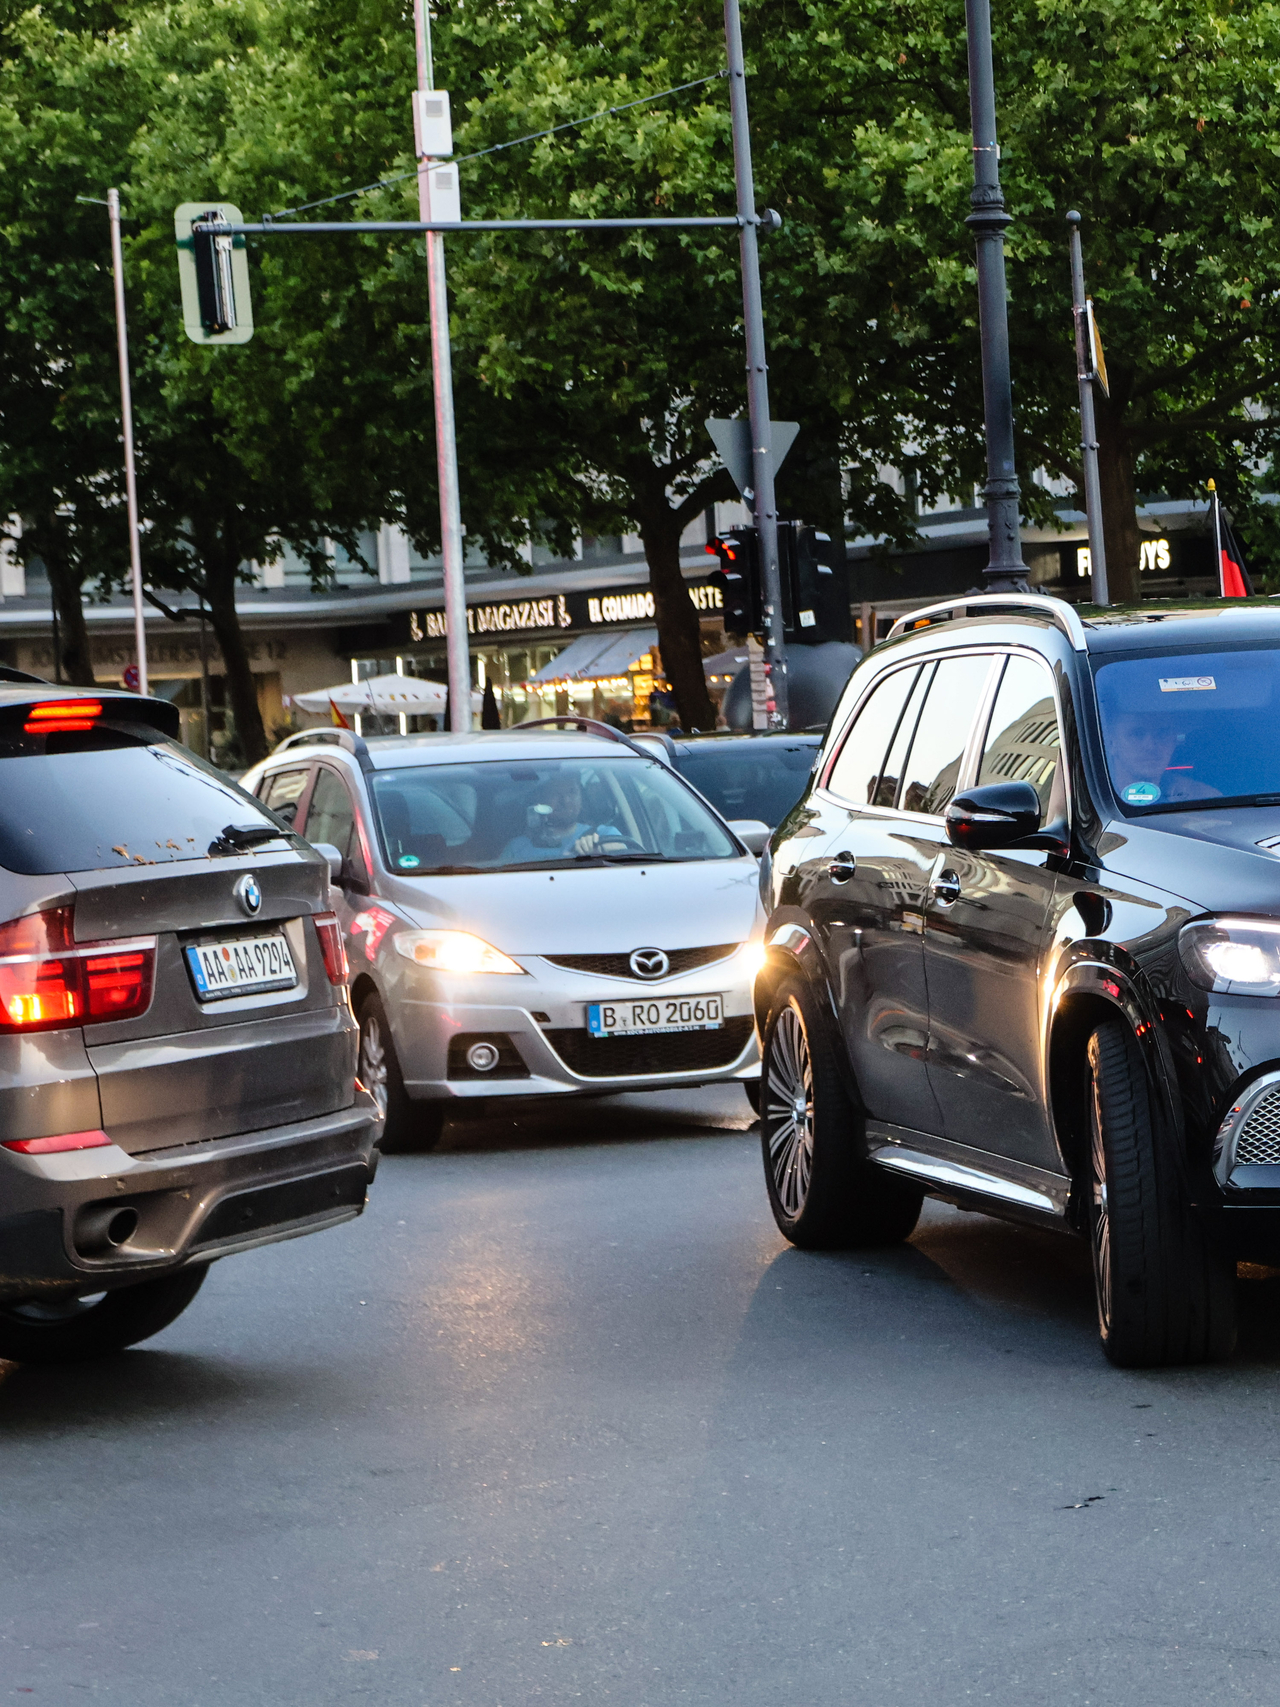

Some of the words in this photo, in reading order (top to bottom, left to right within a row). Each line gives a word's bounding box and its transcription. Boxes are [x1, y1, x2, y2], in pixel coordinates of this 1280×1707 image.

[588, 597, 602, 623] EL
[602, 591, 656, 622] COLMADO
[203, 949, 229, 985] AA
[233, 946, 258, 980] AA
[254, 941, 293, 977] 9294
[603, 1007, 616, 1029] B
[633, 1004, 660, 1027] RO
[666, 999, 719, 1024] 2060
